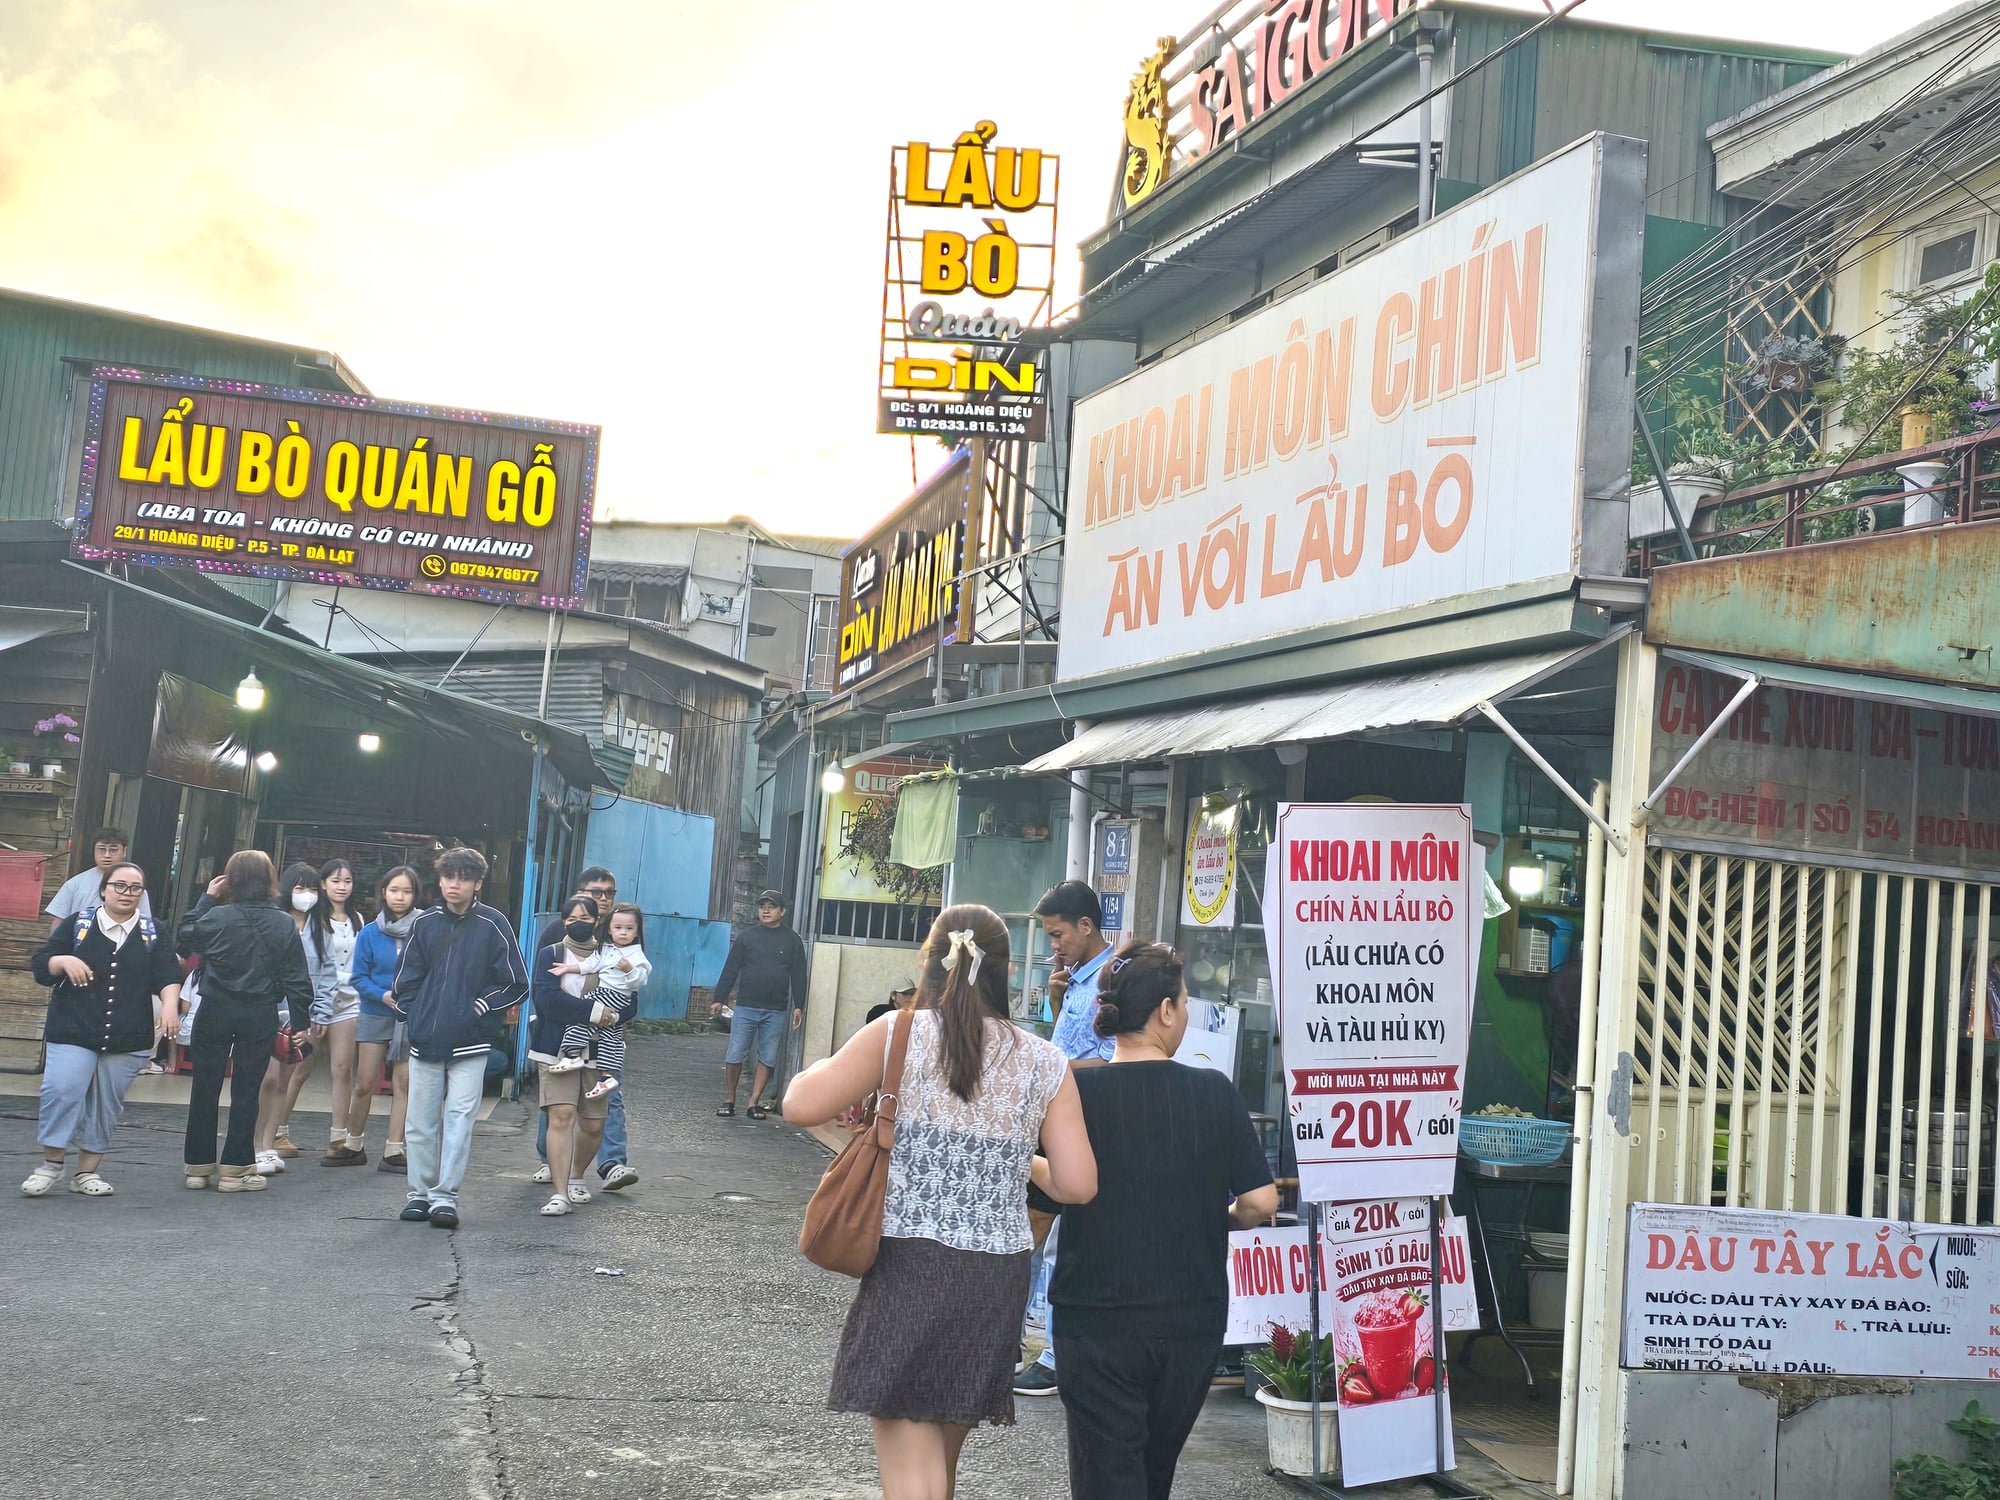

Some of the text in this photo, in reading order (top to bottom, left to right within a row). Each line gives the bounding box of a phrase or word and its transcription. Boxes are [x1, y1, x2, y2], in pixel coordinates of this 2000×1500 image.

[905, 119, 1042, 213] LẨU
[920, 217, 1019, 299] BÒ
[909, 301, 1022, 339] Quán
[893, 347, 1036, 393] DÌN
[1083, 217, 1548, 532] KHOAI MÔN CHÍN
[891, 402, 1032, 420] ĐC: 8/1 HOÀNG DIỆU
[119, 397, 558, 527] LẨU BÒ QUÁN GỖ
[114, 525, 145, 541] 29/1
[149, 529, 199, 546] HOÀNG
[201, 534, 236, 552] DIỆU
[246, 540, 269, 554] P.5
[306, 545, 326, 561] ĐÀ
[329, 549, 355, 566] LẠT
[137, 502, 196, 523] (ABA
[202, 508, 247, 527] TOA
[269, 516, 355, 539] KHÔNG
[359, 526, 394, 544] CÓ
[397, 531, 440, 548] CHI
[442, 536, 535, 560] NHÁNH)
[450, 561, 539, 583] 0979476677
[1793, 803, 1805, 830] 1
[1813, 795, 1851, 835] SỐ
[1864, 809, 1901, 841] 54
[1290, 832, 1459, 882] KHOAI MÔN
[1295, 889, 1454, 922] CHÍN ĂN LẨU BÒ
[1305, 934, 1444, 970] (LẨU CHƯA CÓ
[1316, 977, 1434, 1004] KHOAI MÔN
[1306, 1013, 1445, 1044] VÀ TÀU HỦ KY)
[1307, 1069, 1447, 1090] MỜI MUA TẠI NHÀ NÀY
[1296, 1118, 1324, 1140] GIÁ
[1330, 1099, 1412, 1148] 20K
[1427, 1114, 1454, 1135] GÓI
[1334, 1217, 1350, 1231] GIÁ
[1353, 1201, 1400, 1233] 20K
[1408, 1207, 1424, 1220] GÓI
[1233, 1236, 1284, 1296] MÔN
[1335, 1238, 1430, 1278] SINH TỐ DÂU
[1645, 1225, 1924, 1279] DÂU TÂY LẮC
[1379, 1274, 1395, 1286] XAY
[1645, 1290, 1707, 1305] NƯỚC:
[1711, 1292, 1754, 1306] DÂU
[1759, 1294, 1802, 1308] TÂY
[1806, 1297, 1847, 1309] XAY
[1851, 1297, 1880, 1310] ĐÁ
[1885, 1298, 1931, 1313] BÀO:
[1645, 1312, 1688, 1326] TRÀ
[1693, 1313, 1736, 1328] DÂU
[1741, 1315, 1787, 1329] TÂY:
[1834, 1319, 1848, 1331] K
[1861, 1319, 1903, 1333] TRÀ
[1908, 1321, 1951, 1336] LỰU:
[1644, 1334, 2000, 1357] SINH TỐ DÂU 25K
